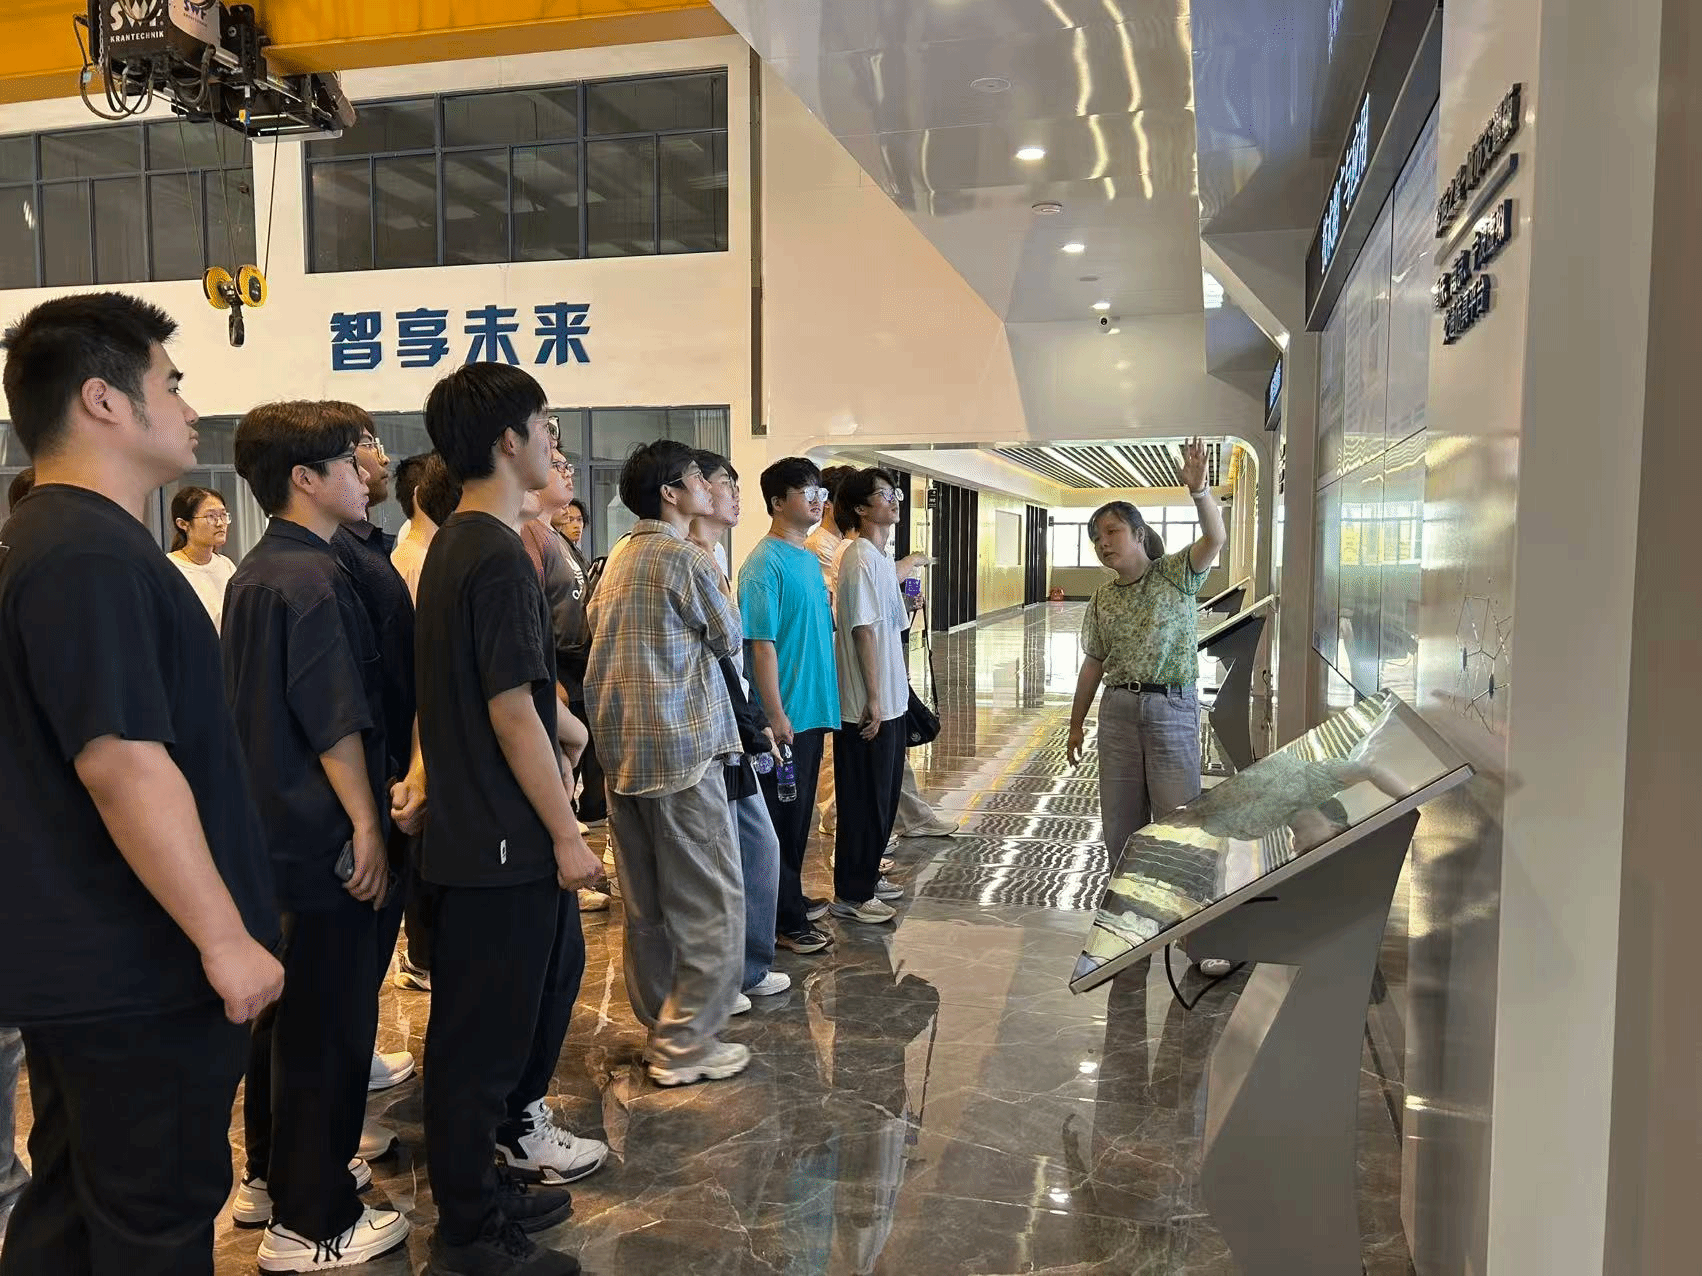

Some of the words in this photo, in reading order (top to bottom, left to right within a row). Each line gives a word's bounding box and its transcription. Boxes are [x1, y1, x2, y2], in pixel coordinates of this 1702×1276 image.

[110, 31, 164, 43] KRANTECHNIK
[330, 302, 590, 370] 智享未来
